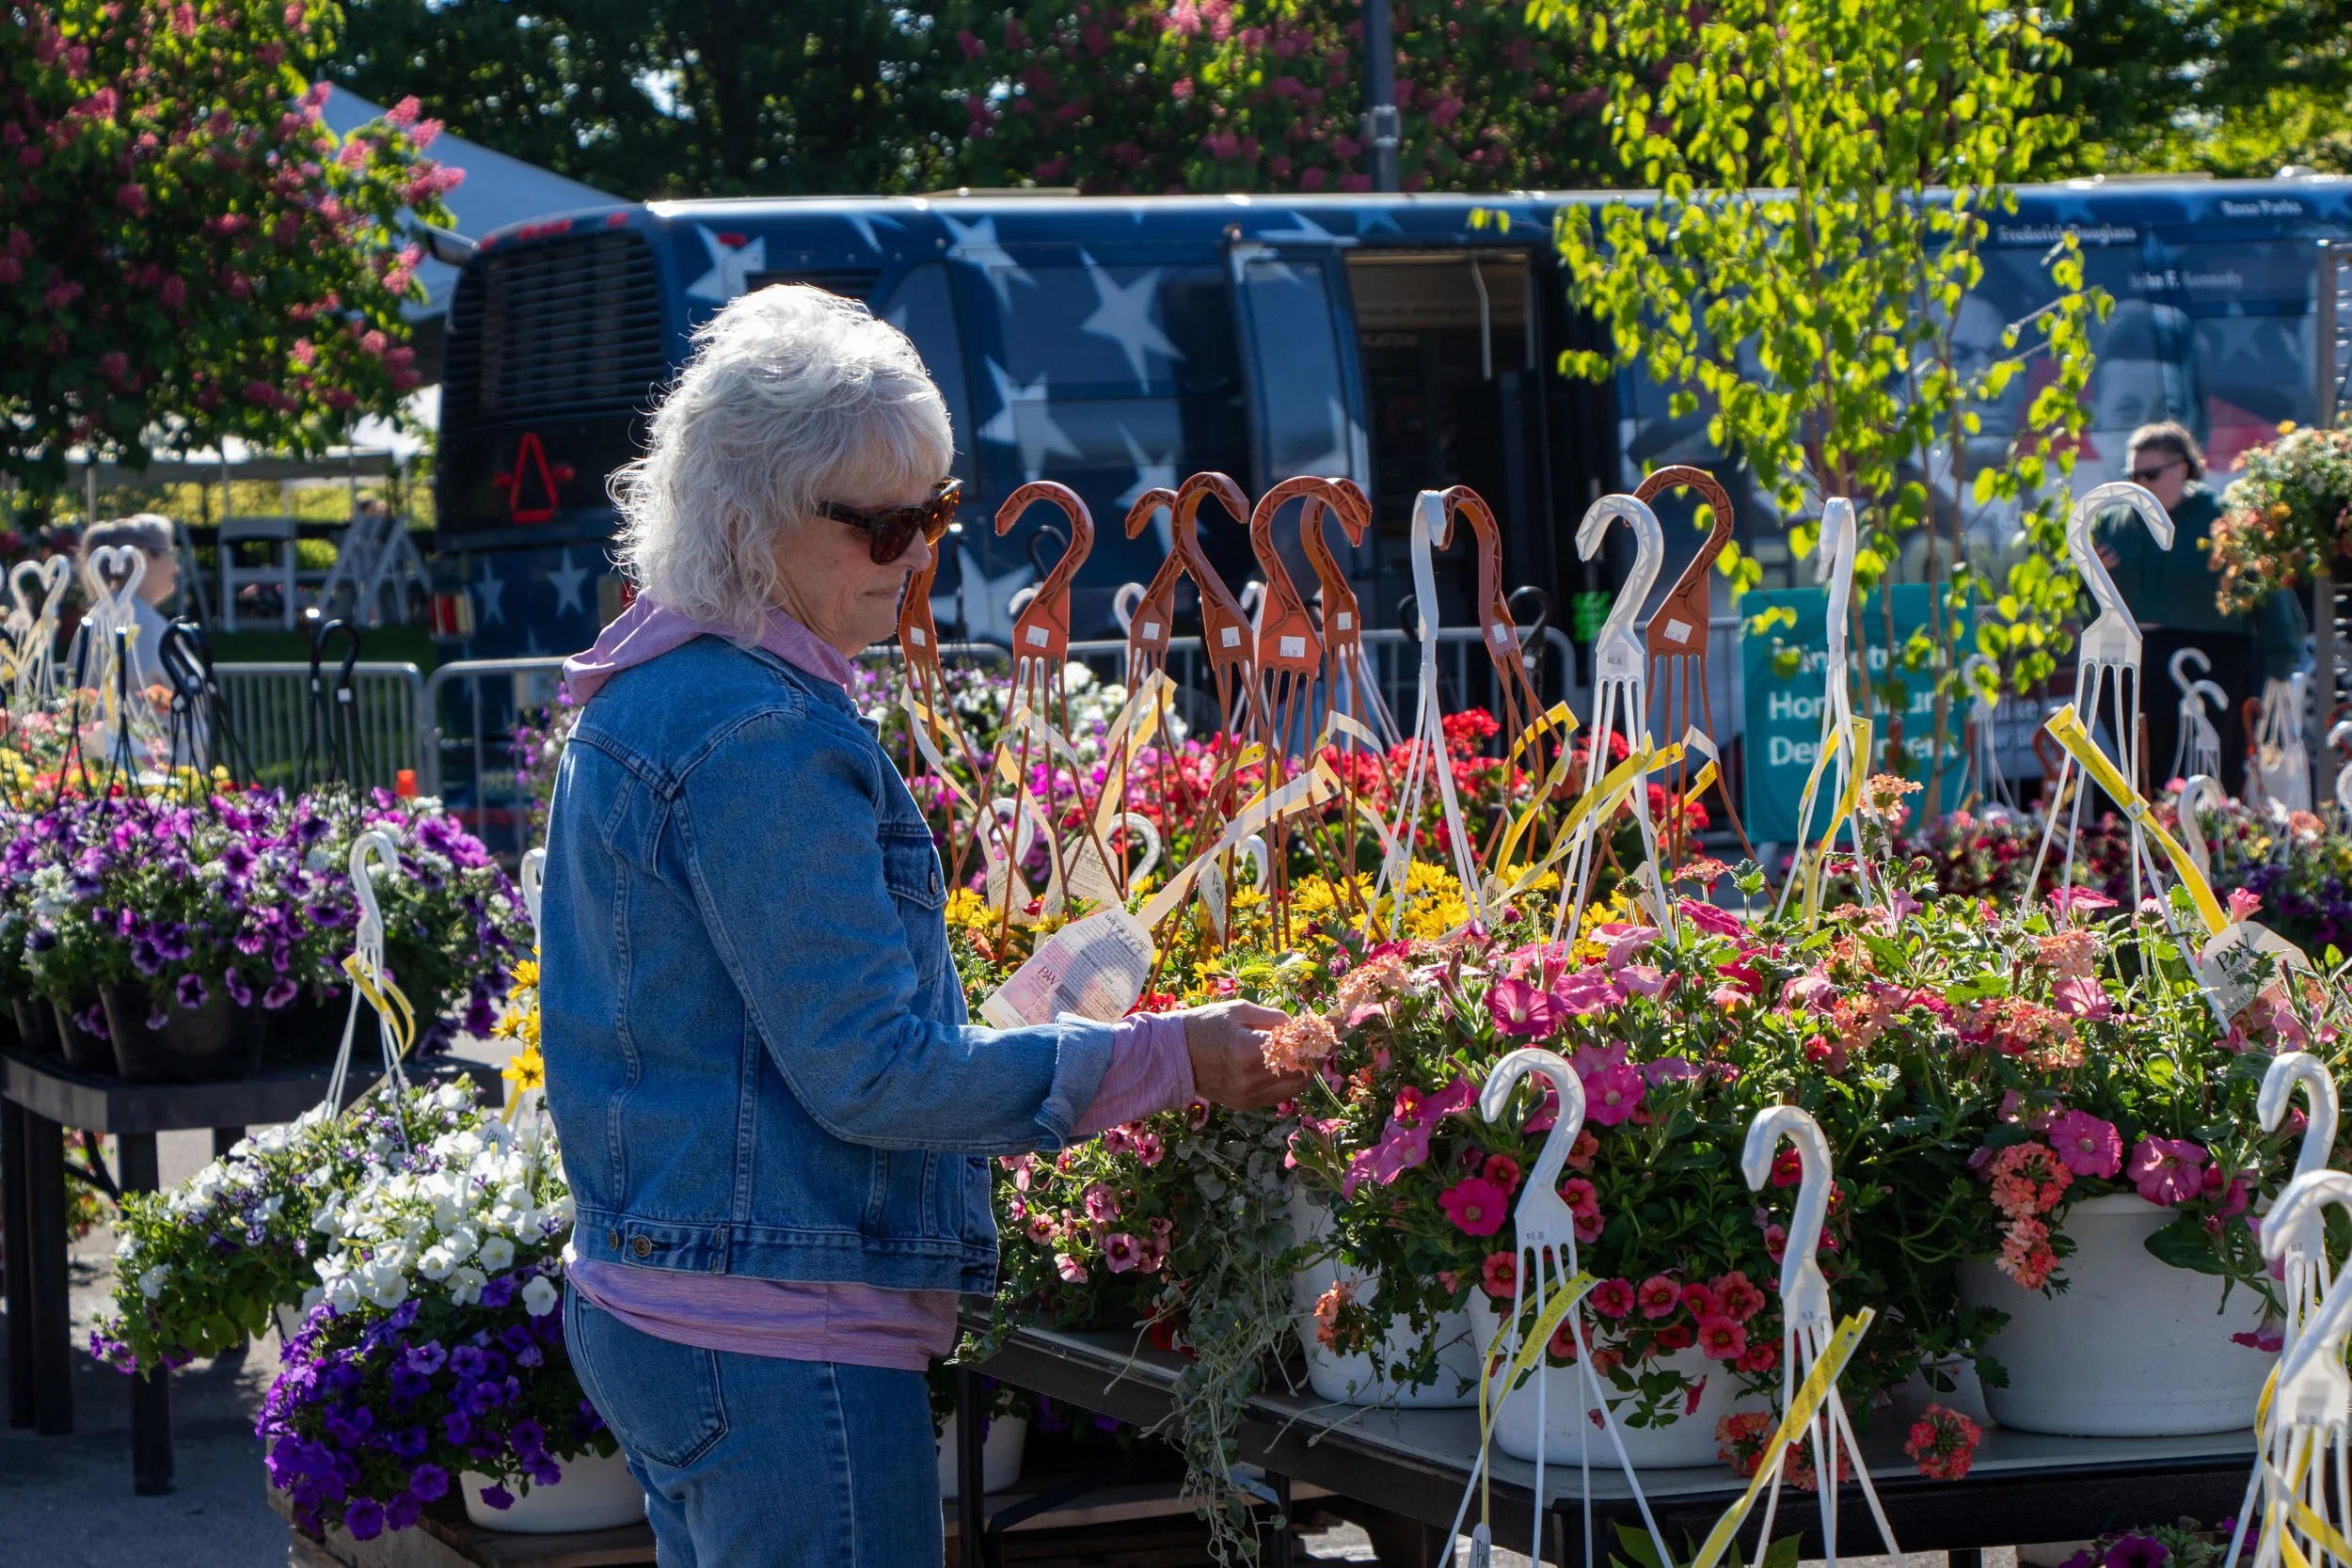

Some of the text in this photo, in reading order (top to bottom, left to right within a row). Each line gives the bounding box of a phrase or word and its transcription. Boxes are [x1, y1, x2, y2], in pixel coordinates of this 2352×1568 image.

[2220, 199, 2302, 216] Rosa Parks
[2129, 270, 2243, 292] John F. Kennedy
[1280, 648, 1298, 657] $45.00
[1526, 1230, 1544, 1241] $45.00
[1523, 1289, 1573, 1364] NO WORK ALL PLAY
